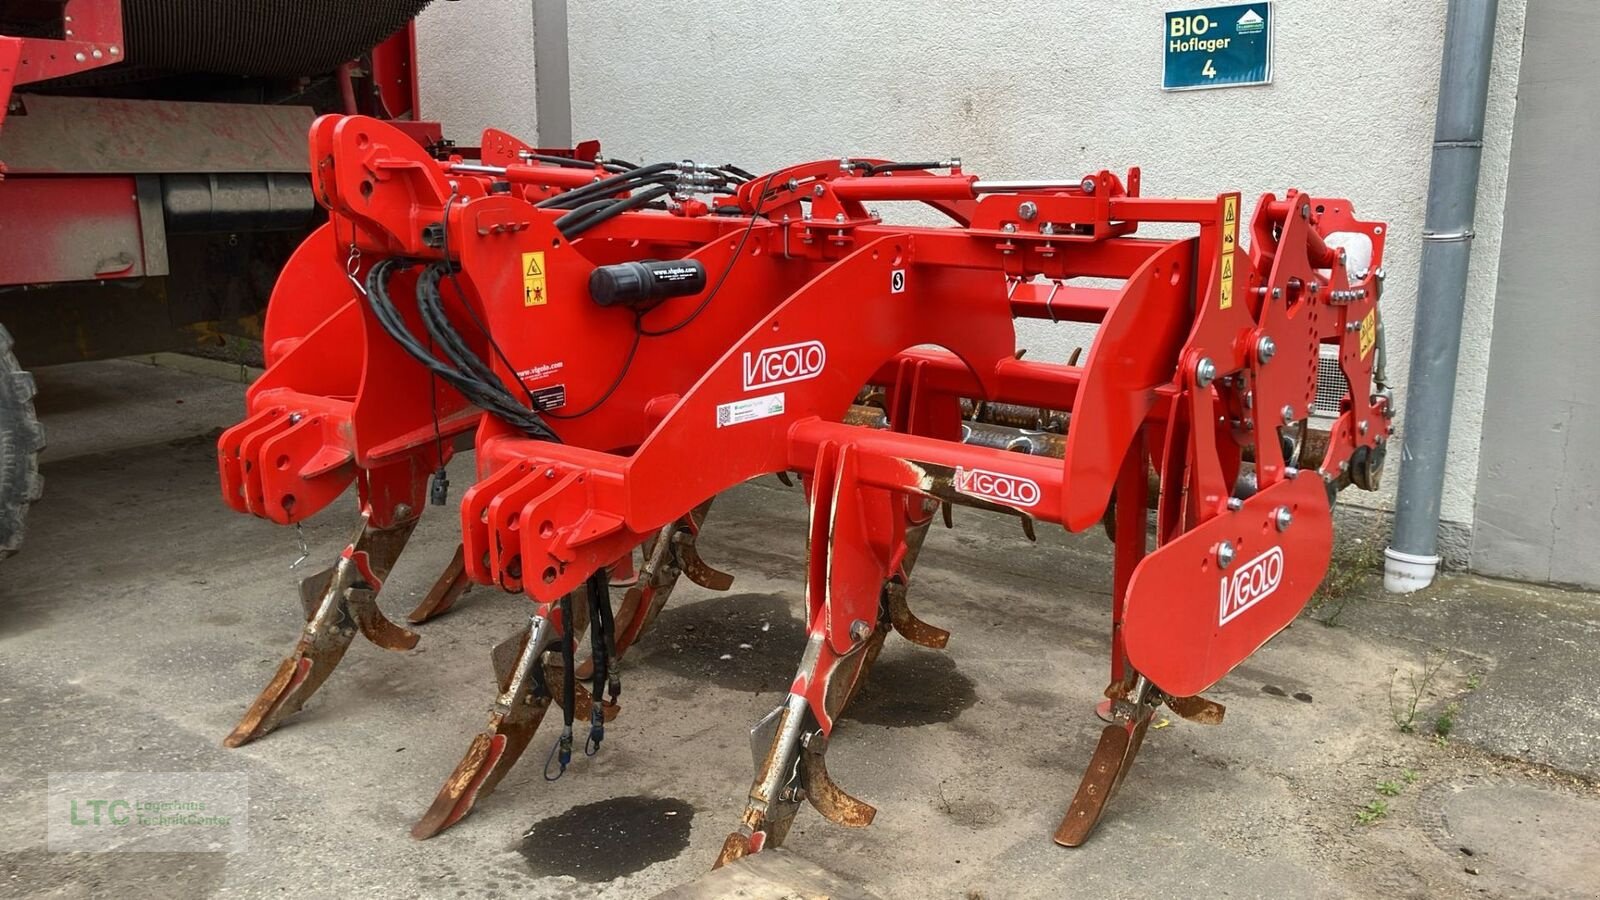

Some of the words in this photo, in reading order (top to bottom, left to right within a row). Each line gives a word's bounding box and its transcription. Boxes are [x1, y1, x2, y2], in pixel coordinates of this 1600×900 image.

[1170, 15, 1218, 37] BIO-
[1169, 37, 1231, 53] Hoflager
[1202, 59, 1217, 79] 4
[743, 344, 824, 389] VIGOLO
[955, 465, 1038, 505] VIGOLO
[1219, 549, 1283, 624] VIGOLO
